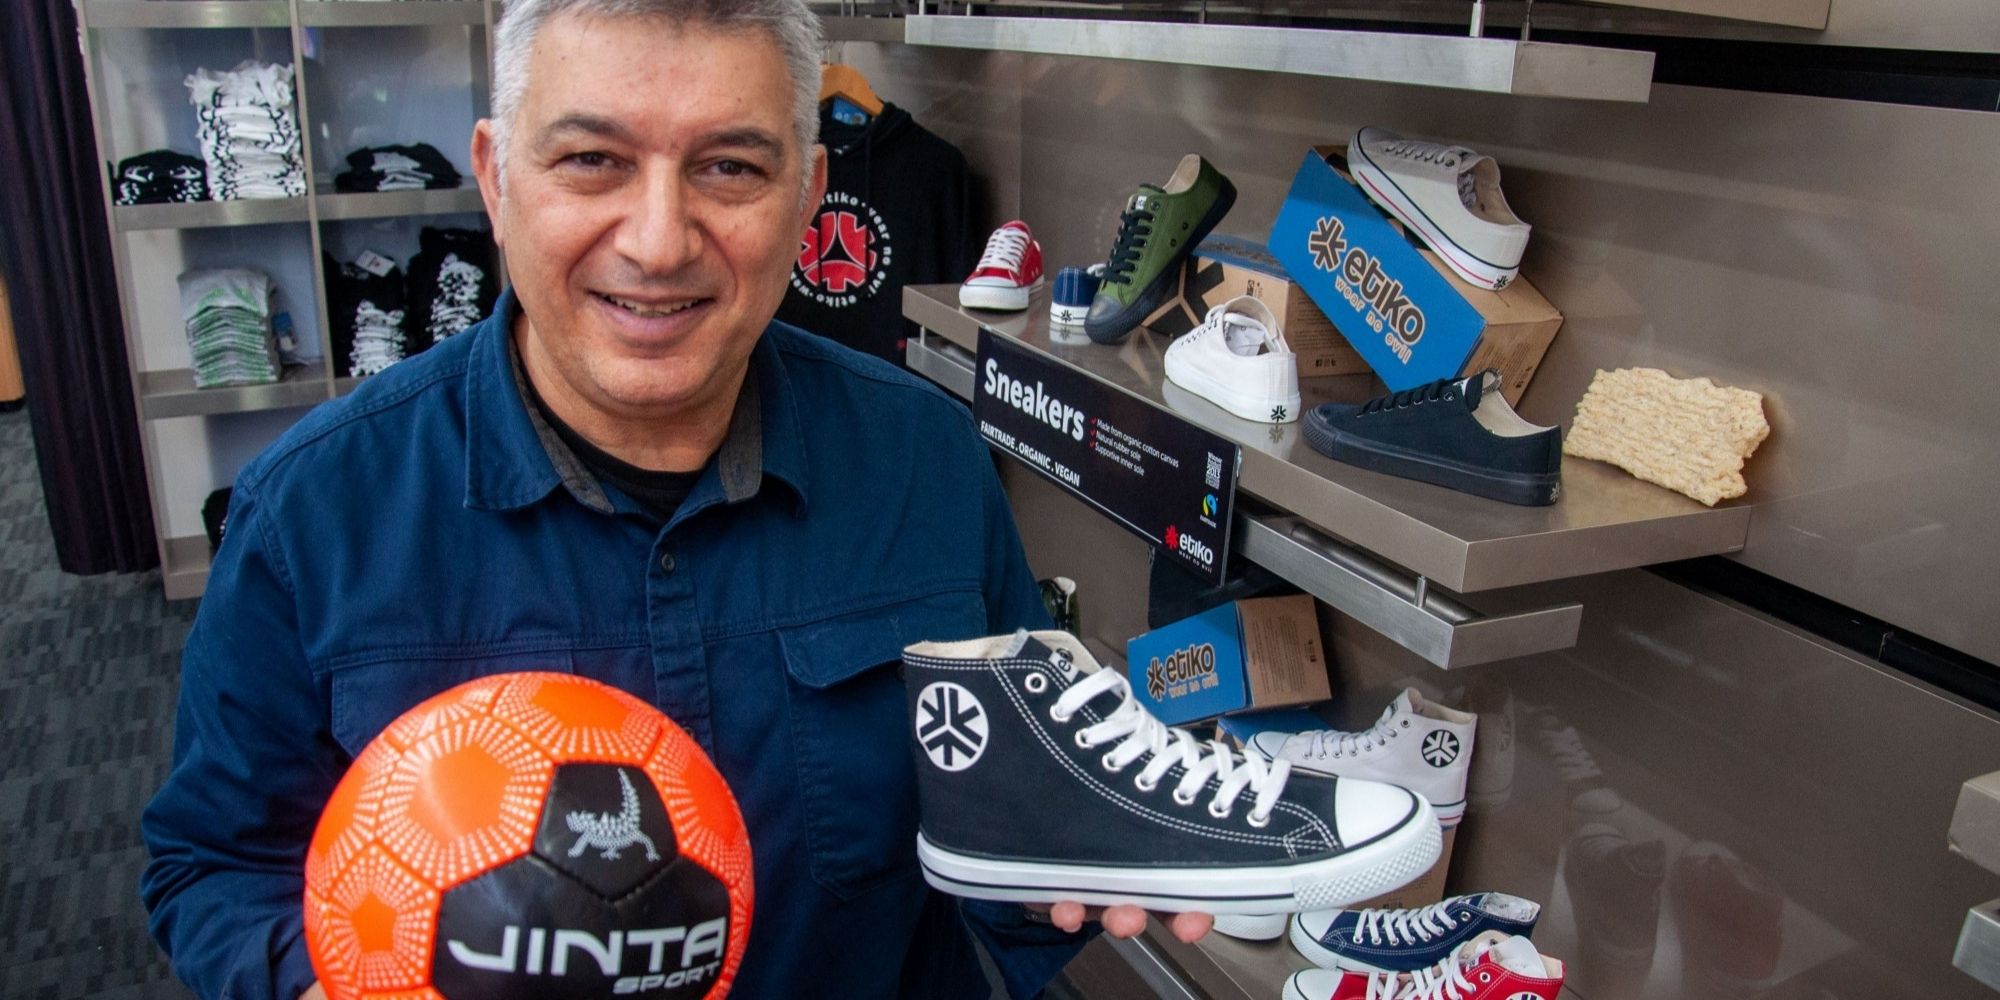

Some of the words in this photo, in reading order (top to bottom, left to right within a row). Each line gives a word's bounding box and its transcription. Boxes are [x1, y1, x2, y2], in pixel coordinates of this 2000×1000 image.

[821, 191, 858, 206] tiko
[868, 207, 890, 240] wear
[883, 246, 892, 266] no
[816, 294, 857, 308] etiko
[1335, 275, 1366, 313] wear
[1366, 311, 1383, 333] no
[1343, 247, 1425, 346] etiko
[984, 358, 1085, 441] Sneakers
[980, 420, 1016, 449] FAIRTRADE
[1018, 442, 1051, 470] ORGANIC
[1054, 461, 1080, 487] VEGAN
[1095, 441, 1120, 463] Supportive
[1120, 456, 1133, 470] inner
[1133, 463, 1145, 477] sole
[1096, 430, 1114, 446] Natural
[1113, 441, 1130, 455] rubber
[1130, 450, 1142, 462] sole
[1097, 418, 1110, 433] Made
[1110, 425, 1123, 439] from
[1122, 433, 1142, 449] organic
[1142, 443, 1160, 459] cotton
[1160, 452, 1179, 468] canvas
[1180, 533, 1213, 565] etiko
[1165, 643, 1215, 685] etiko
[447, 917, 726, 976] JINTA
[611, 959, 722, 996] SPORT
